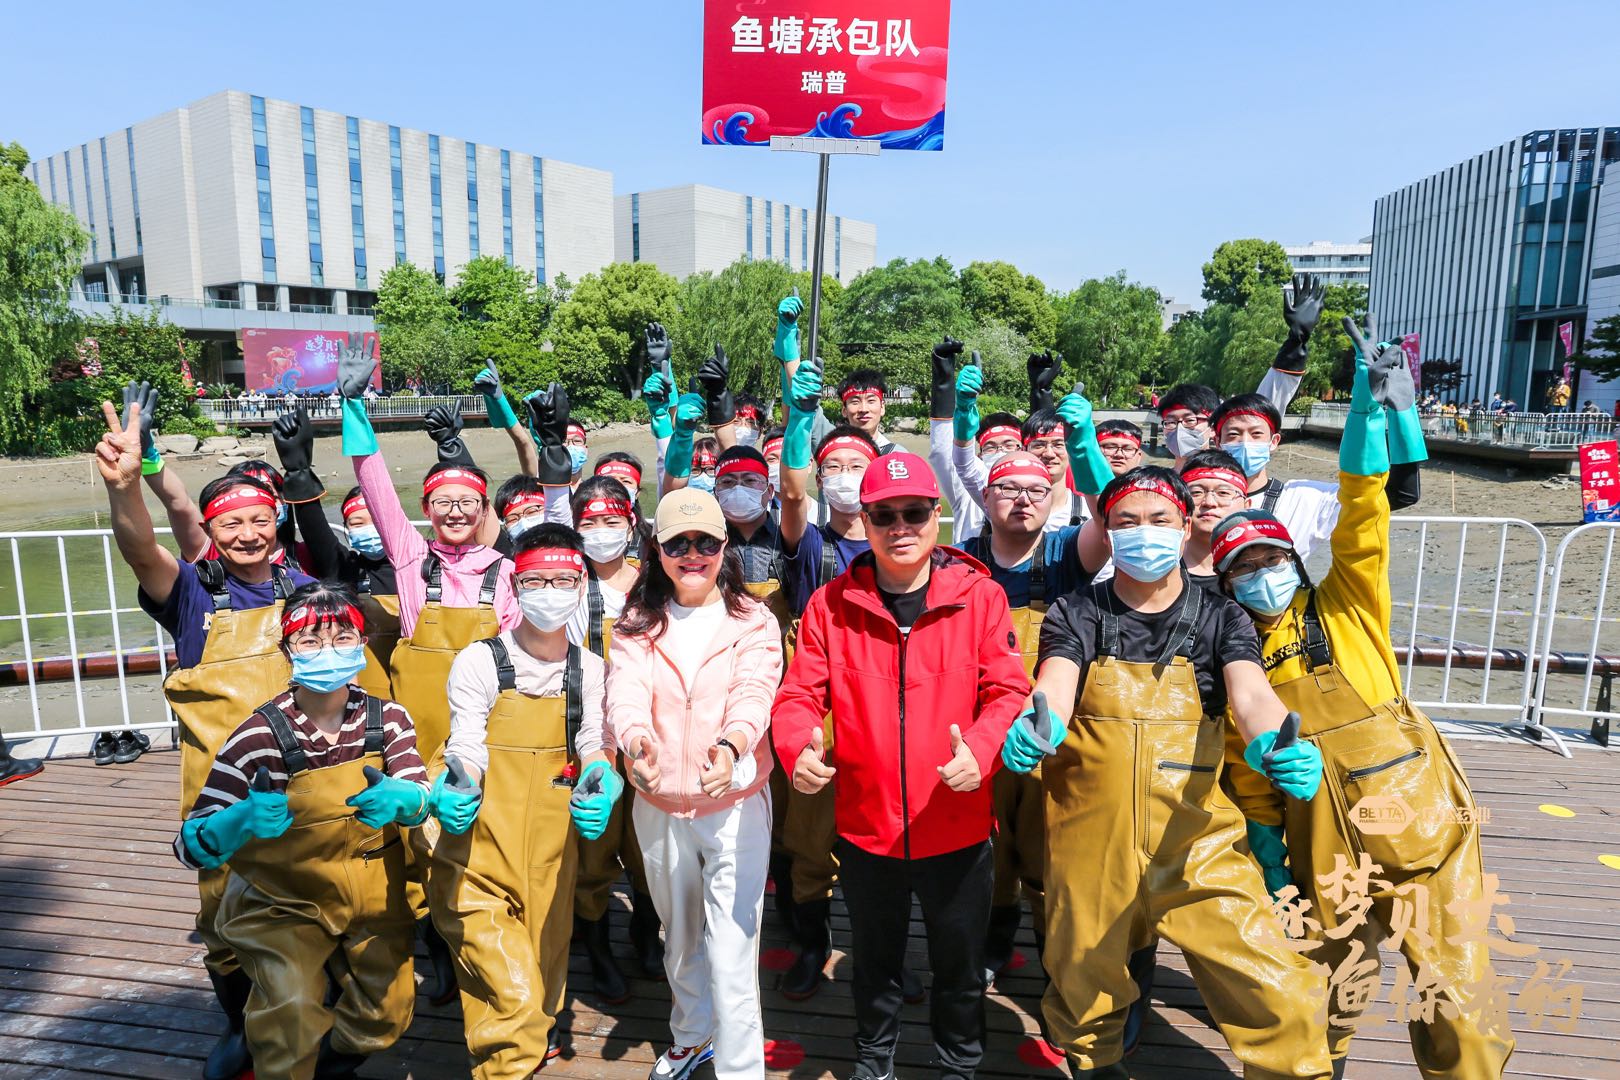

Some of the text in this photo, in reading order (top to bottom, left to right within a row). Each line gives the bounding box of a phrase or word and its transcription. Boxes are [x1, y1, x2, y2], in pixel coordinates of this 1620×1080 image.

[731, 15, 920, 57] 鱼塘承包队
[800, 70, 847, 94] 瑞普
[305, 334, 338, 352] 逐梦贝
